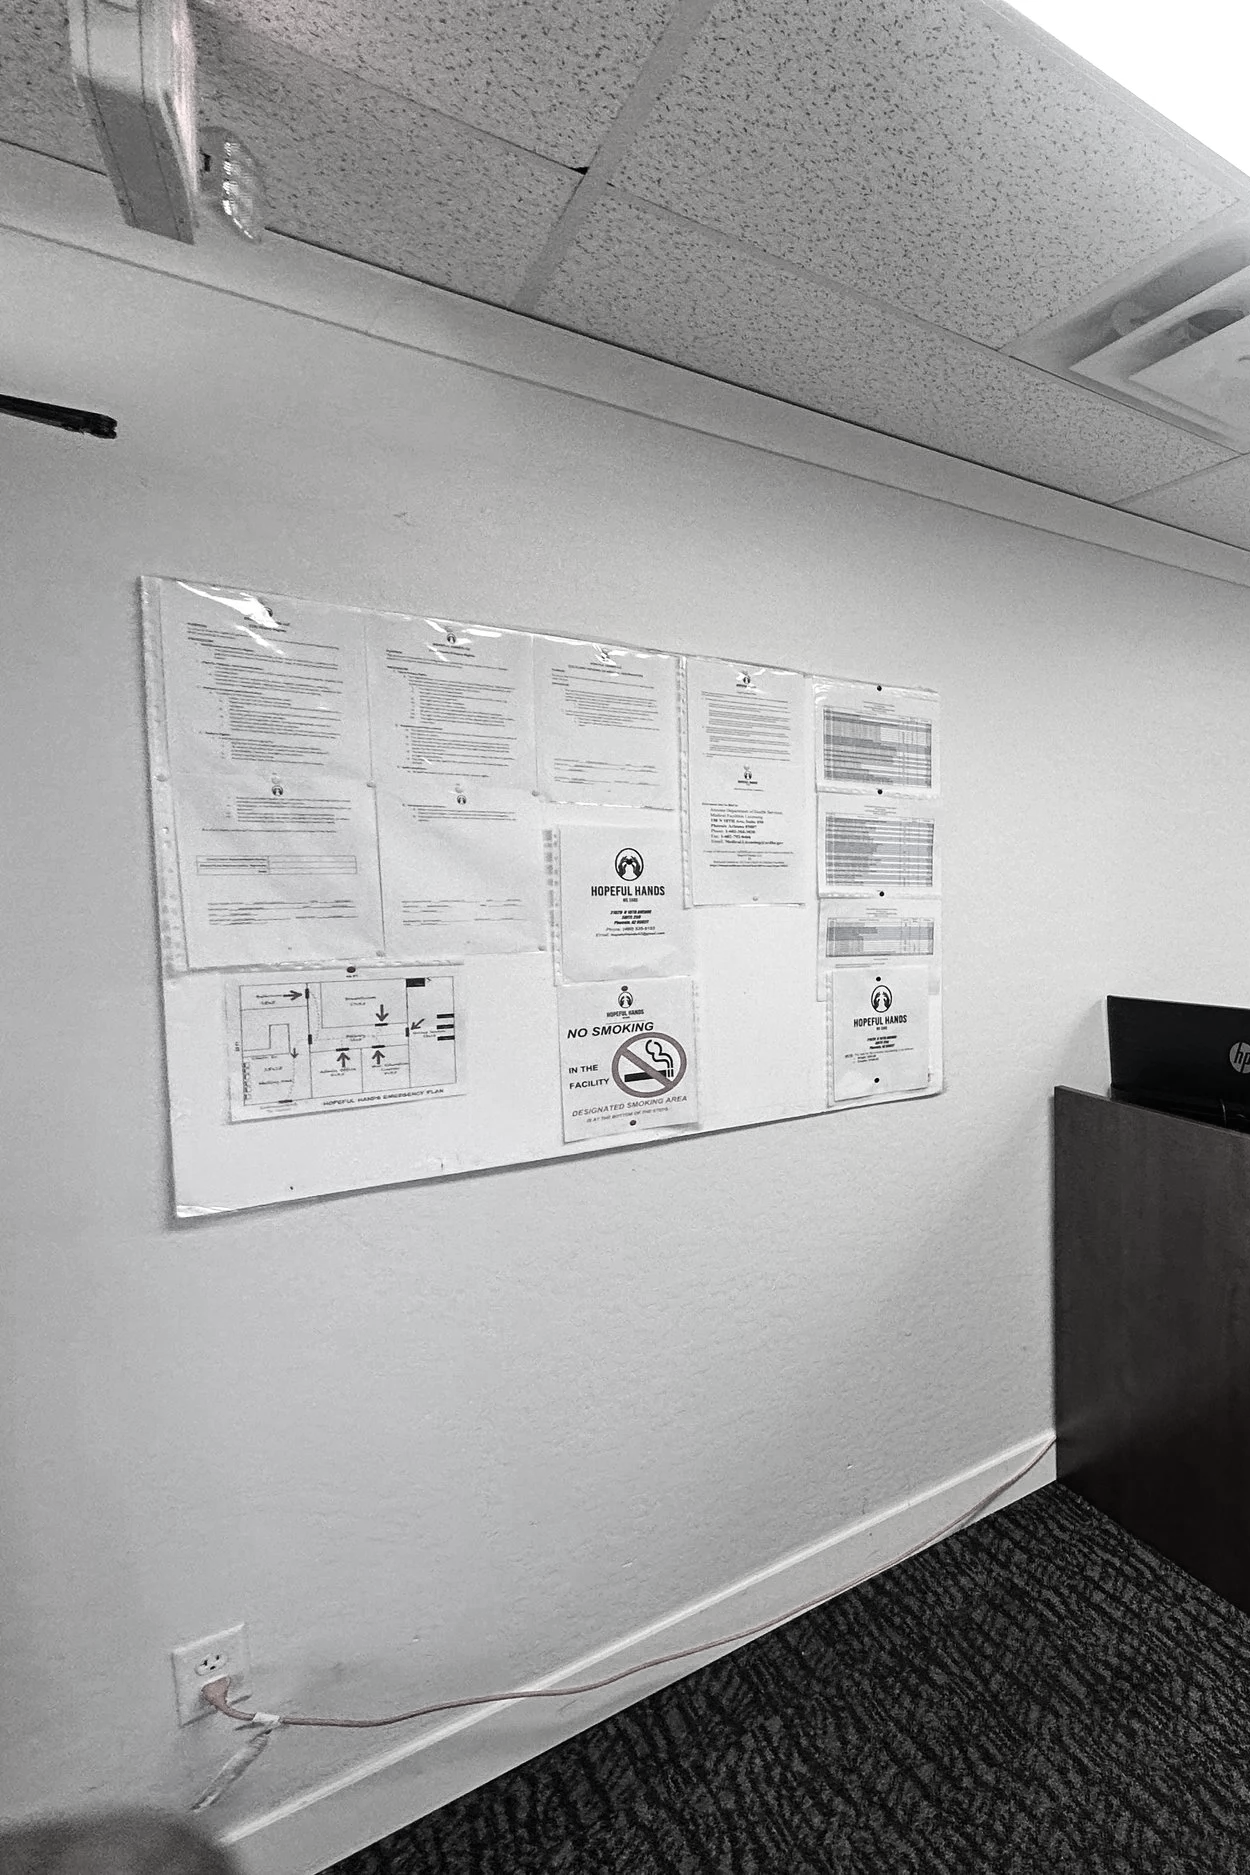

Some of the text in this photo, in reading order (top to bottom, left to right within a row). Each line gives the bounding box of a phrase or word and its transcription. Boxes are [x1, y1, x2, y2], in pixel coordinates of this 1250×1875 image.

[591, 886, 665, 896] HOPEFUL HANDS
[854, 1015, 907, 1027] HOPEFUL HANDS
[567, 1022, 654, 1039] NO SMOKING
[580, 1064, 599, 1073] THE
[569, 1078, 610, 1089] FACILITY
[572, 1095, 687, 1116] DESIGNATED SMOKING AREA
